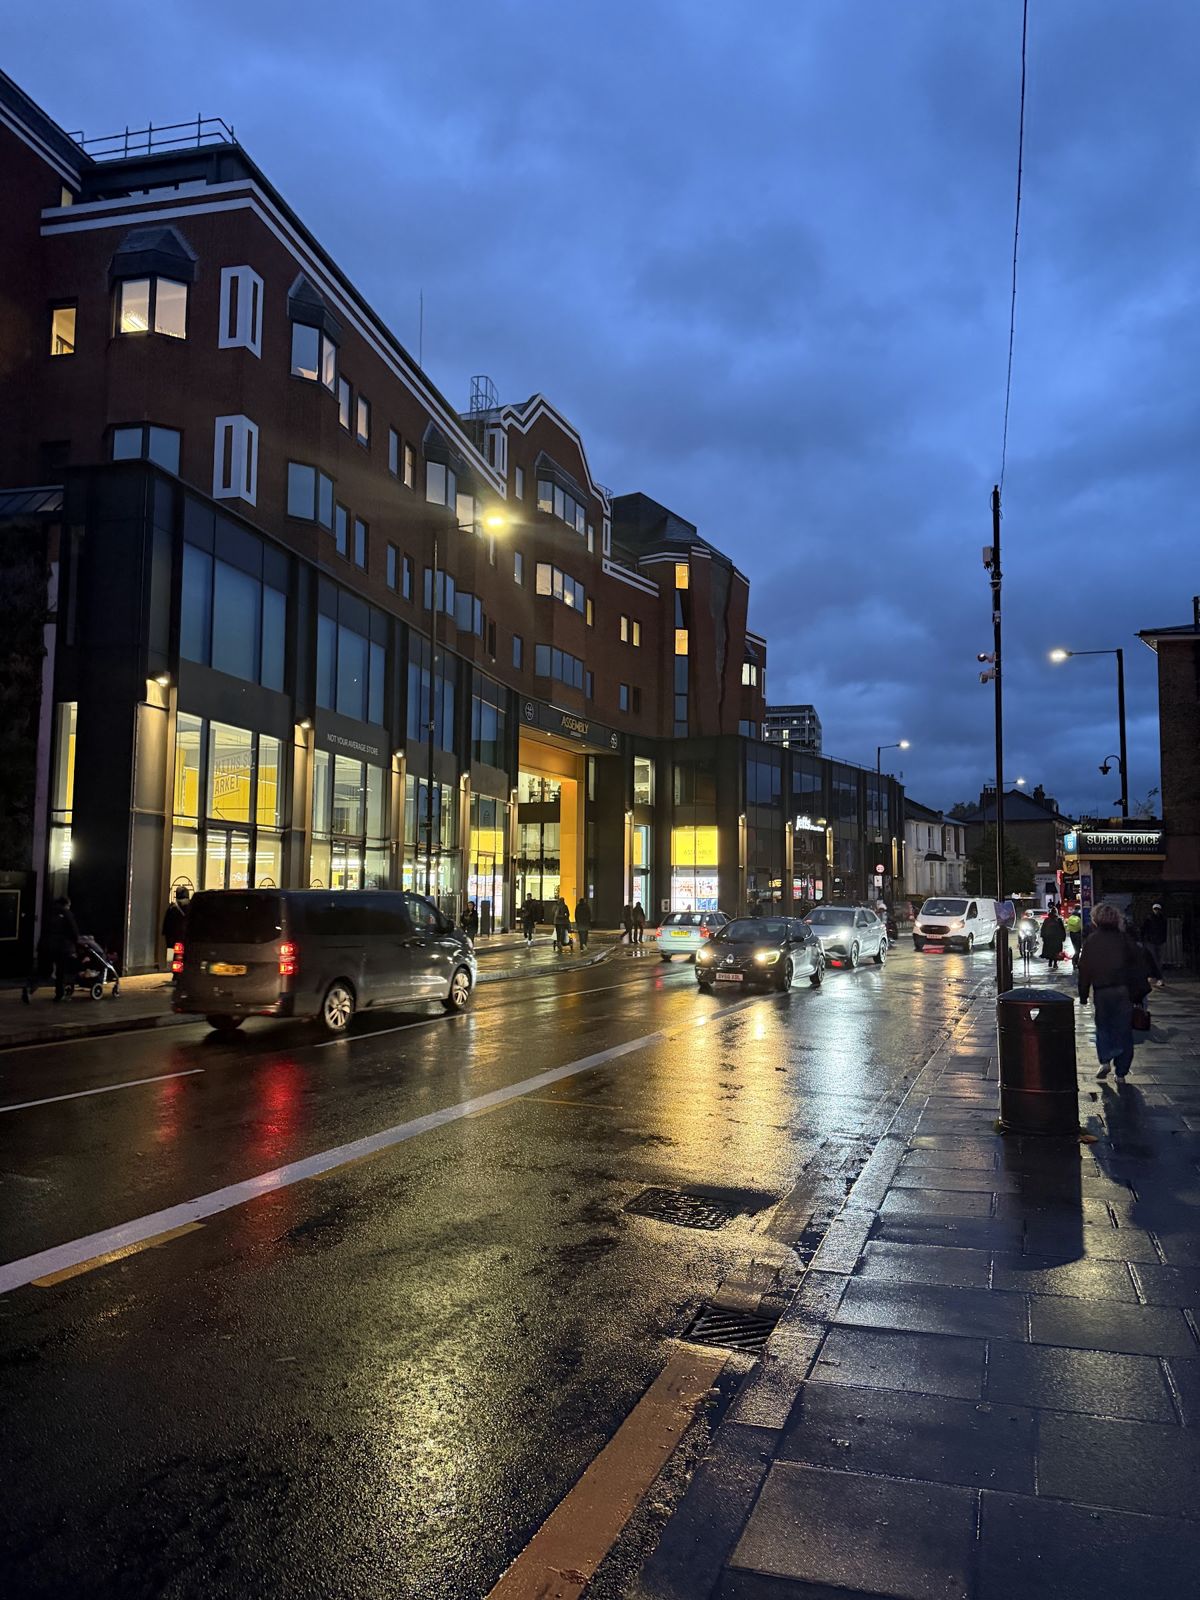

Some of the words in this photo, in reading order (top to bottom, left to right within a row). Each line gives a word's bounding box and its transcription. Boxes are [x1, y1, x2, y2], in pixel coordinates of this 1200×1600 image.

[561, 716, 589, 734] ASSEMBLY
[327, 733, 337, 743] NOT
[214, 774, 239, 795] ARKET
[1086, 835, 1120, 845] SUPER
[1121, 835, 1160, 845] CHOICE
